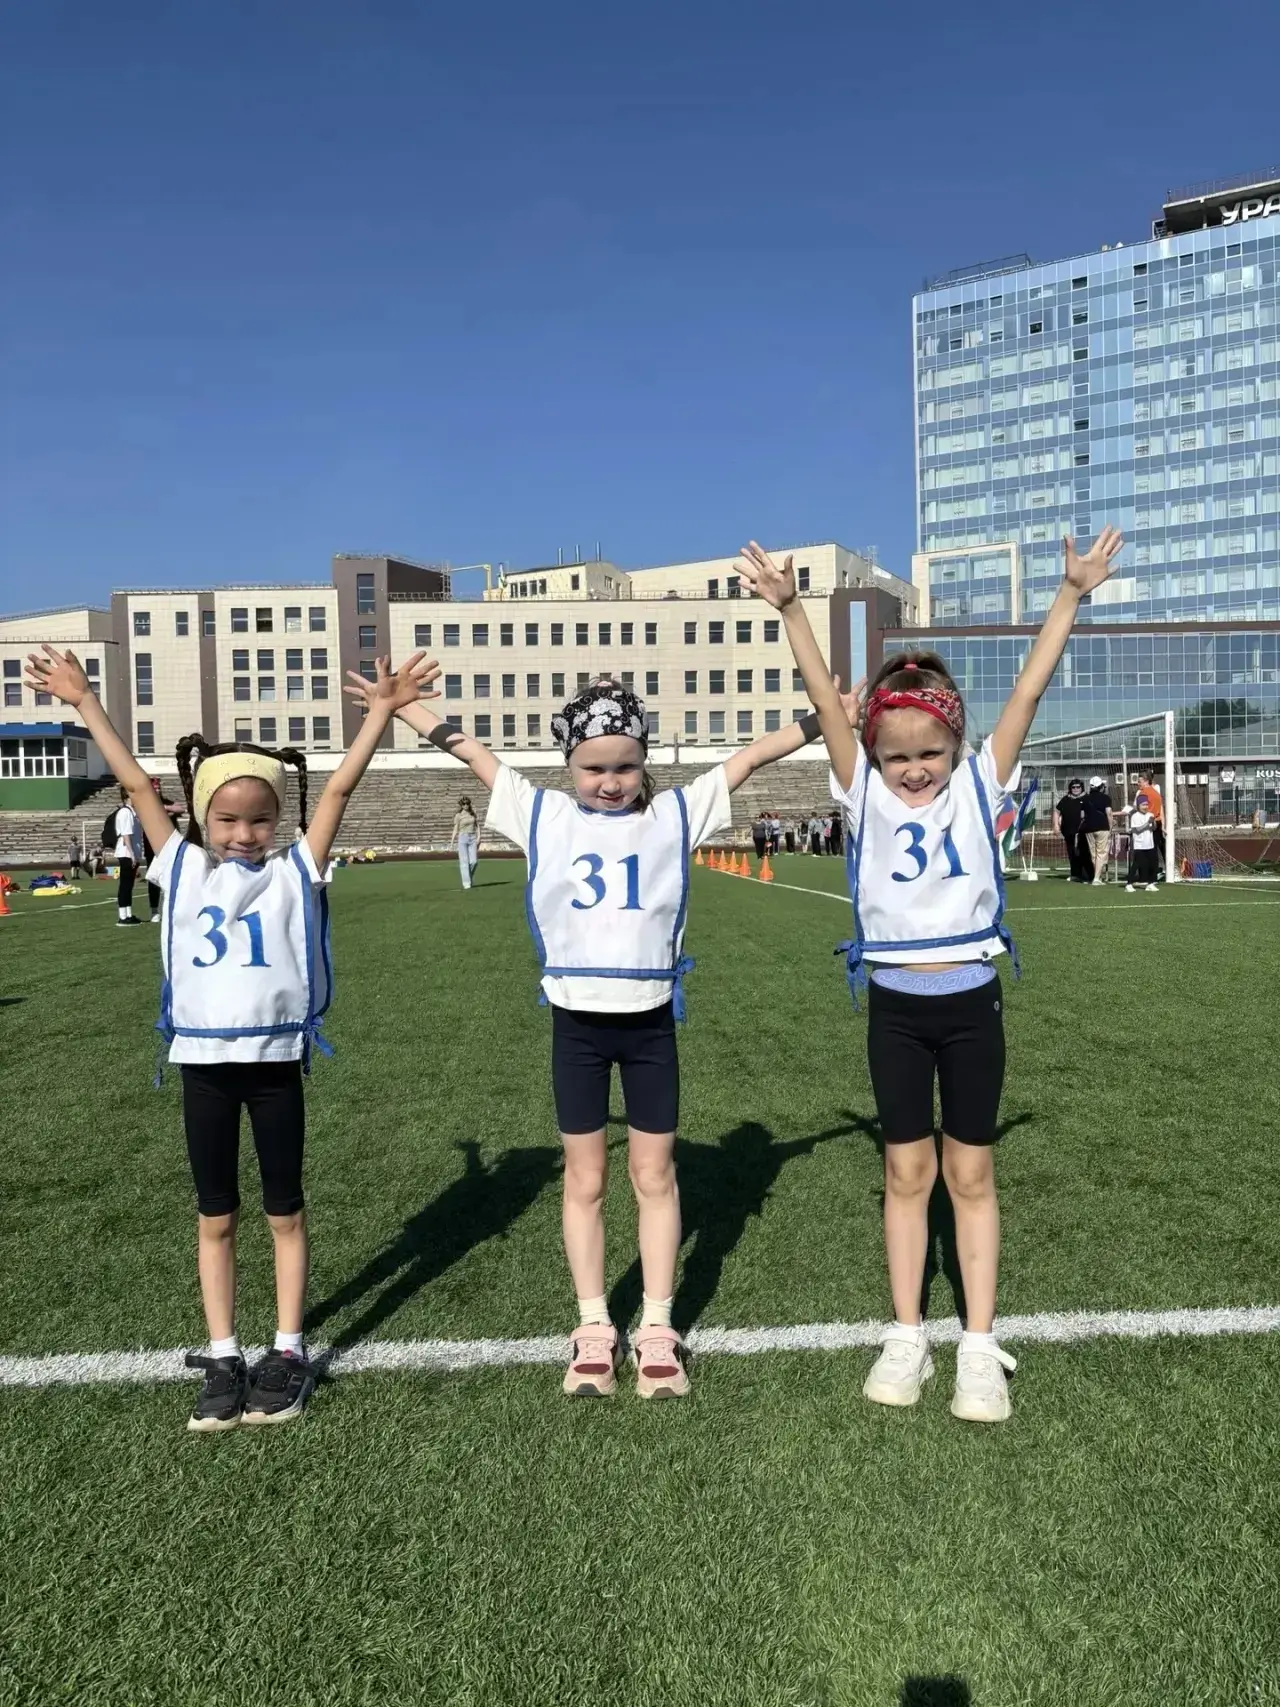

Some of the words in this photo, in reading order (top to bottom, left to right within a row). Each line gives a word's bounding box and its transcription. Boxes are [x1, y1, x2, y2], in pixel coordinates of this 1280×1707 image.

[571, 853, 646, 910] 31
[892, 821, 970, 882] 31
[192, 905, 272, 967] 31
